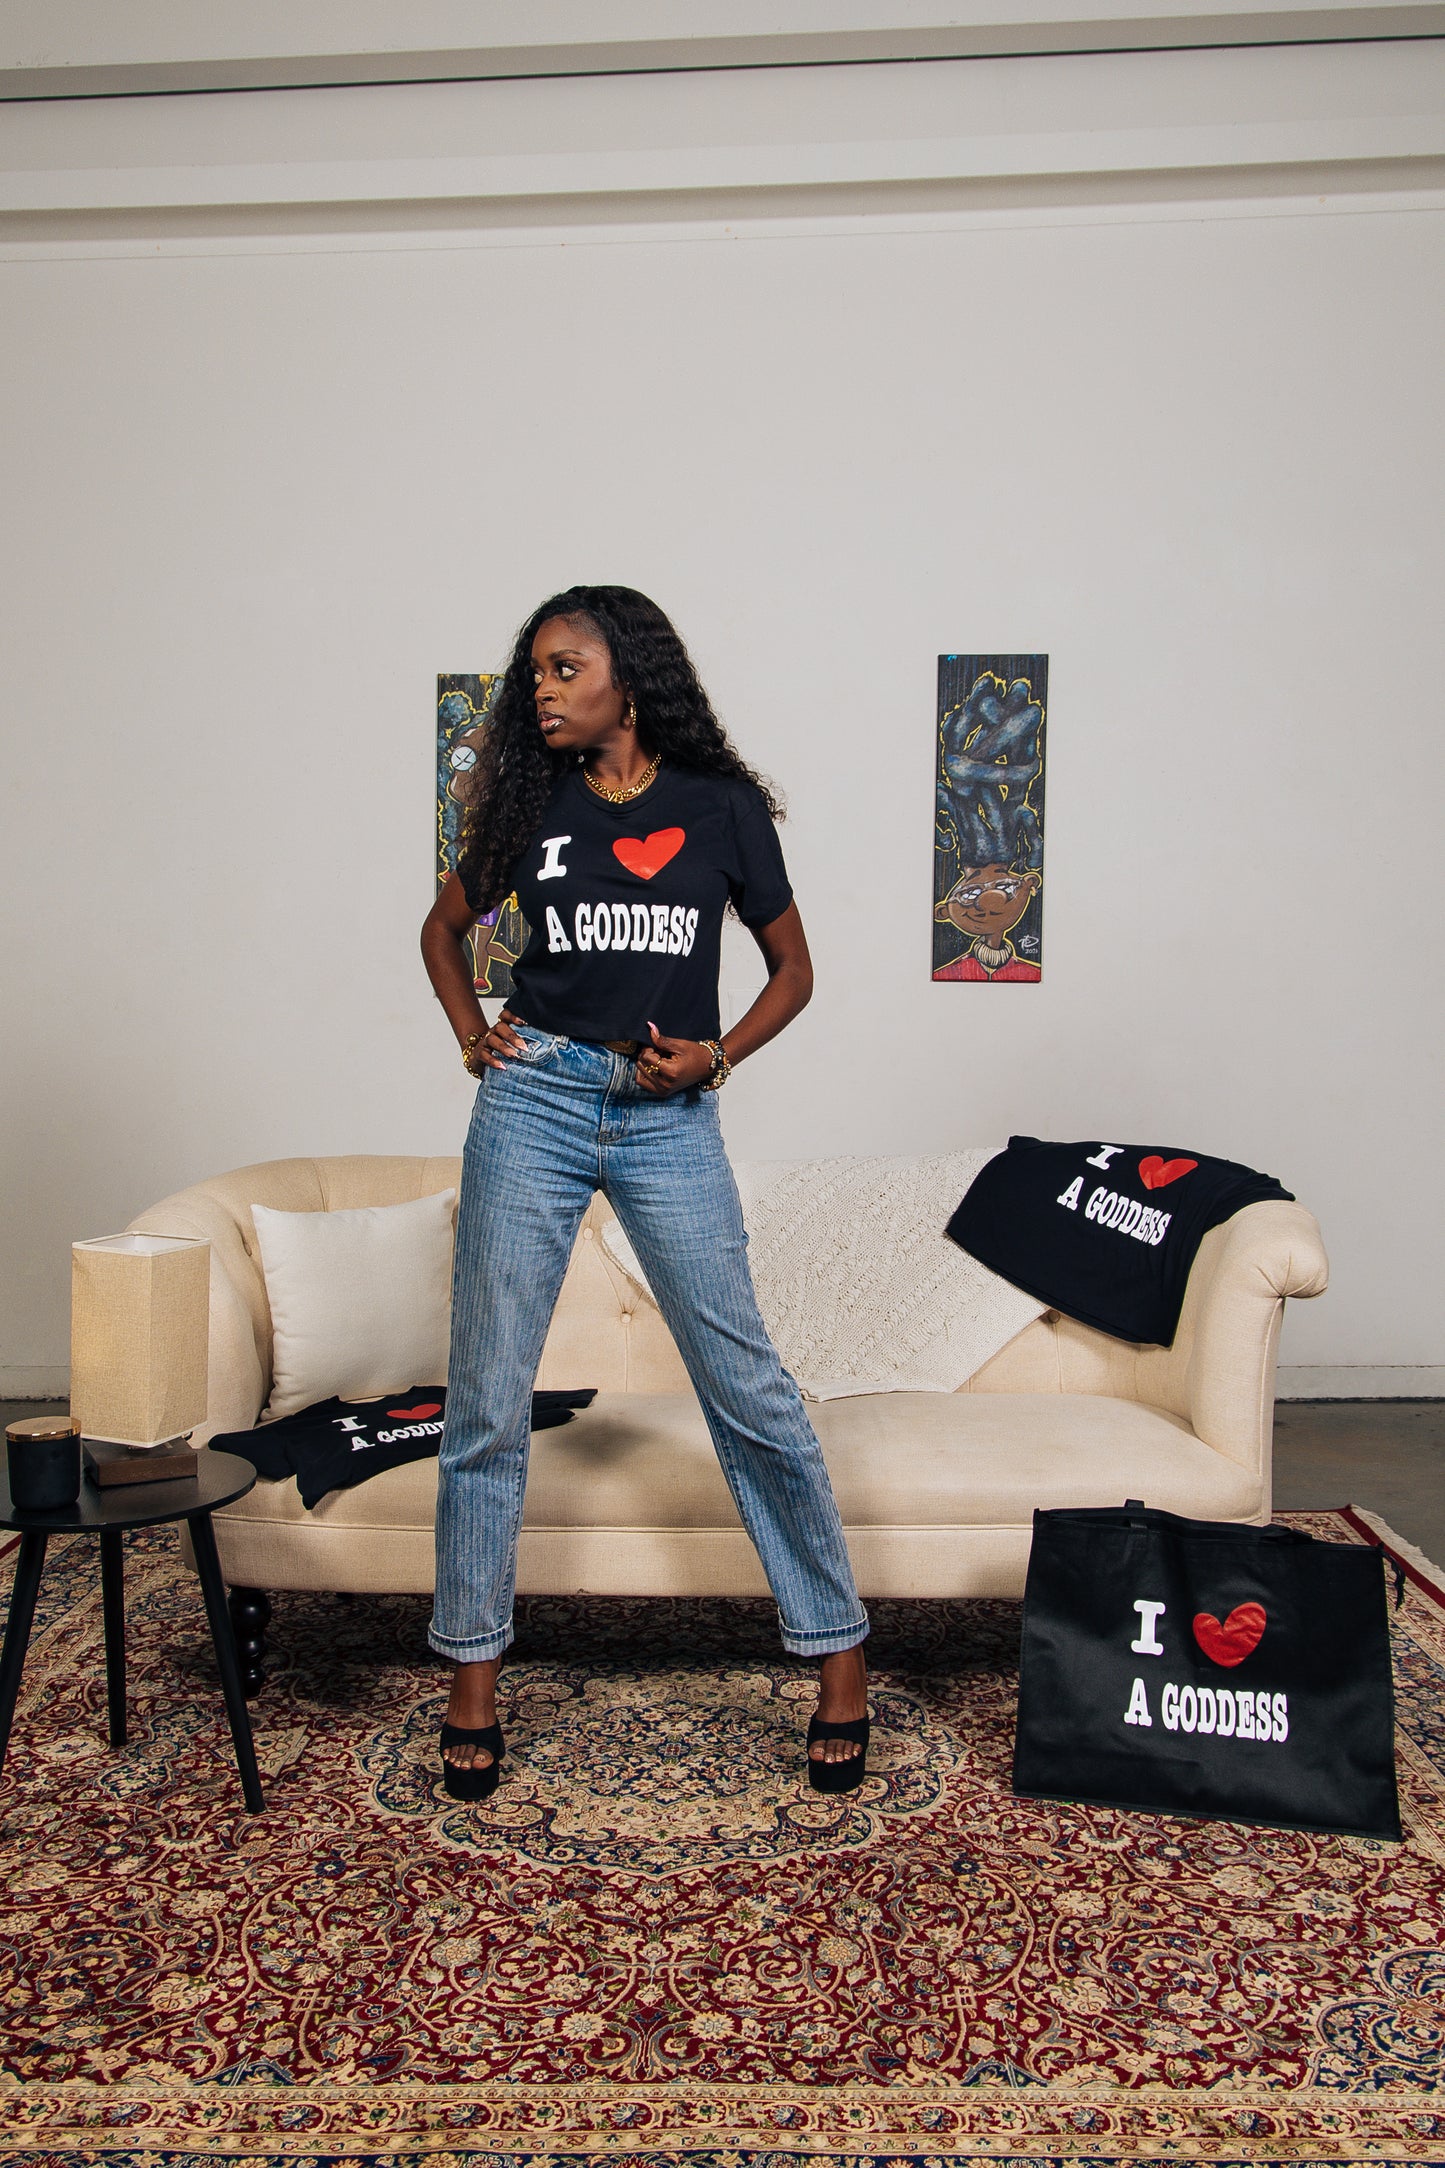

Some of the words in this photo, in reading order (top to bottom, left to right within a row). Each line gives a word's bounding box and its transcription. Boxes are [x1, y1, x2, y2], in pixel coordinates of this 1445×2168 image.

[536, 835, 572, 882] I
[545, 905, 573, 954] A
[574, 902, 700, 958] GODDESS
[1085, 1144, 1125, 1171] I
[1056, 1176, 1084, 1209] A
[1084, 1186, 1172, 1246] GODDESS
[331, 1415, 368, 1432] I
[351, 1436, 376, 1452] A
[1130, 1599, 1166, 1656] I
[1123, 1677, 1153, 1728] A
[1161, 1682, 1289, 1743] GODDESS
